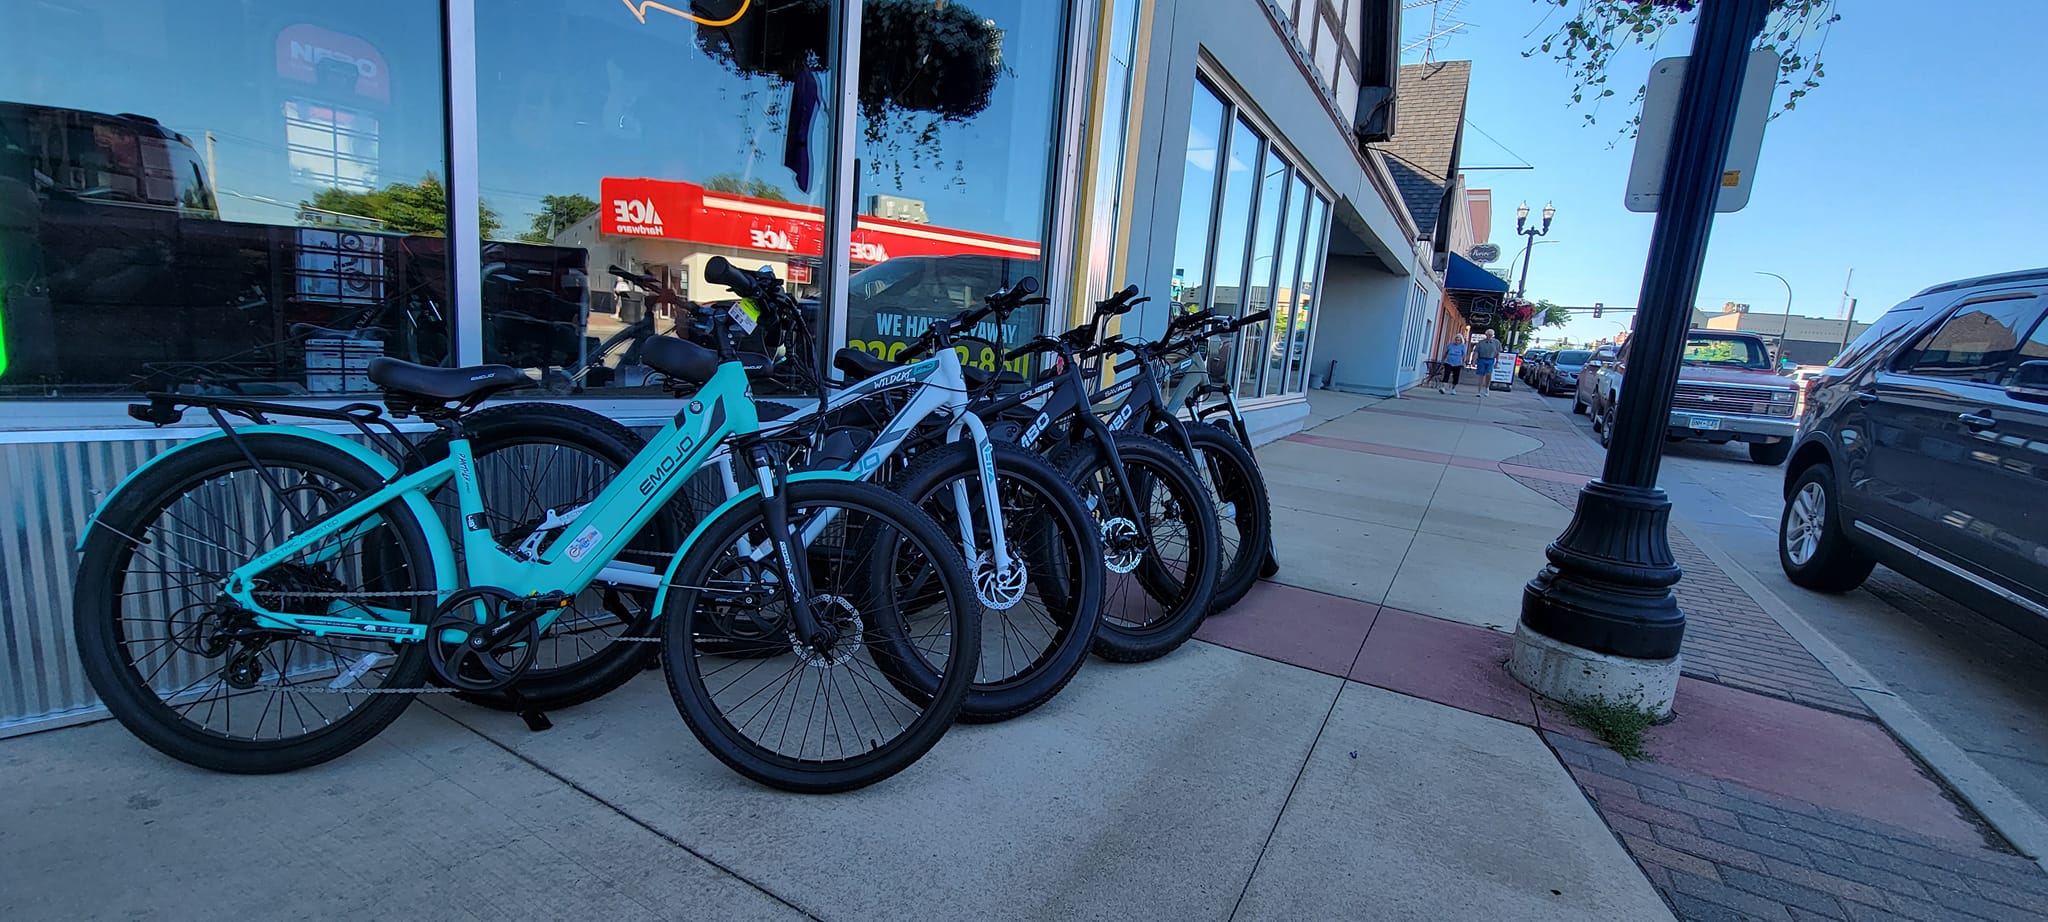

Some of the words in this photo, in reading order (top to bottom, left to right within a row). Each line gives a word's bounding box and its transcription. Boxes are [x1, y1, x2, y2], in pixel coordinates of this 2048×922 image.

[876, 312, 903, 337] WE
[905, 315, 949, 339] HA
[950, 320, 1018, 344] YAWAY
[873, 368, 913, 390] WILDCAT
[1019, 380, 1055, 400] CRUISER
[1103, 380, 1134, 398] SAVAGE
[640, 435, 694, 496] EMOJO
